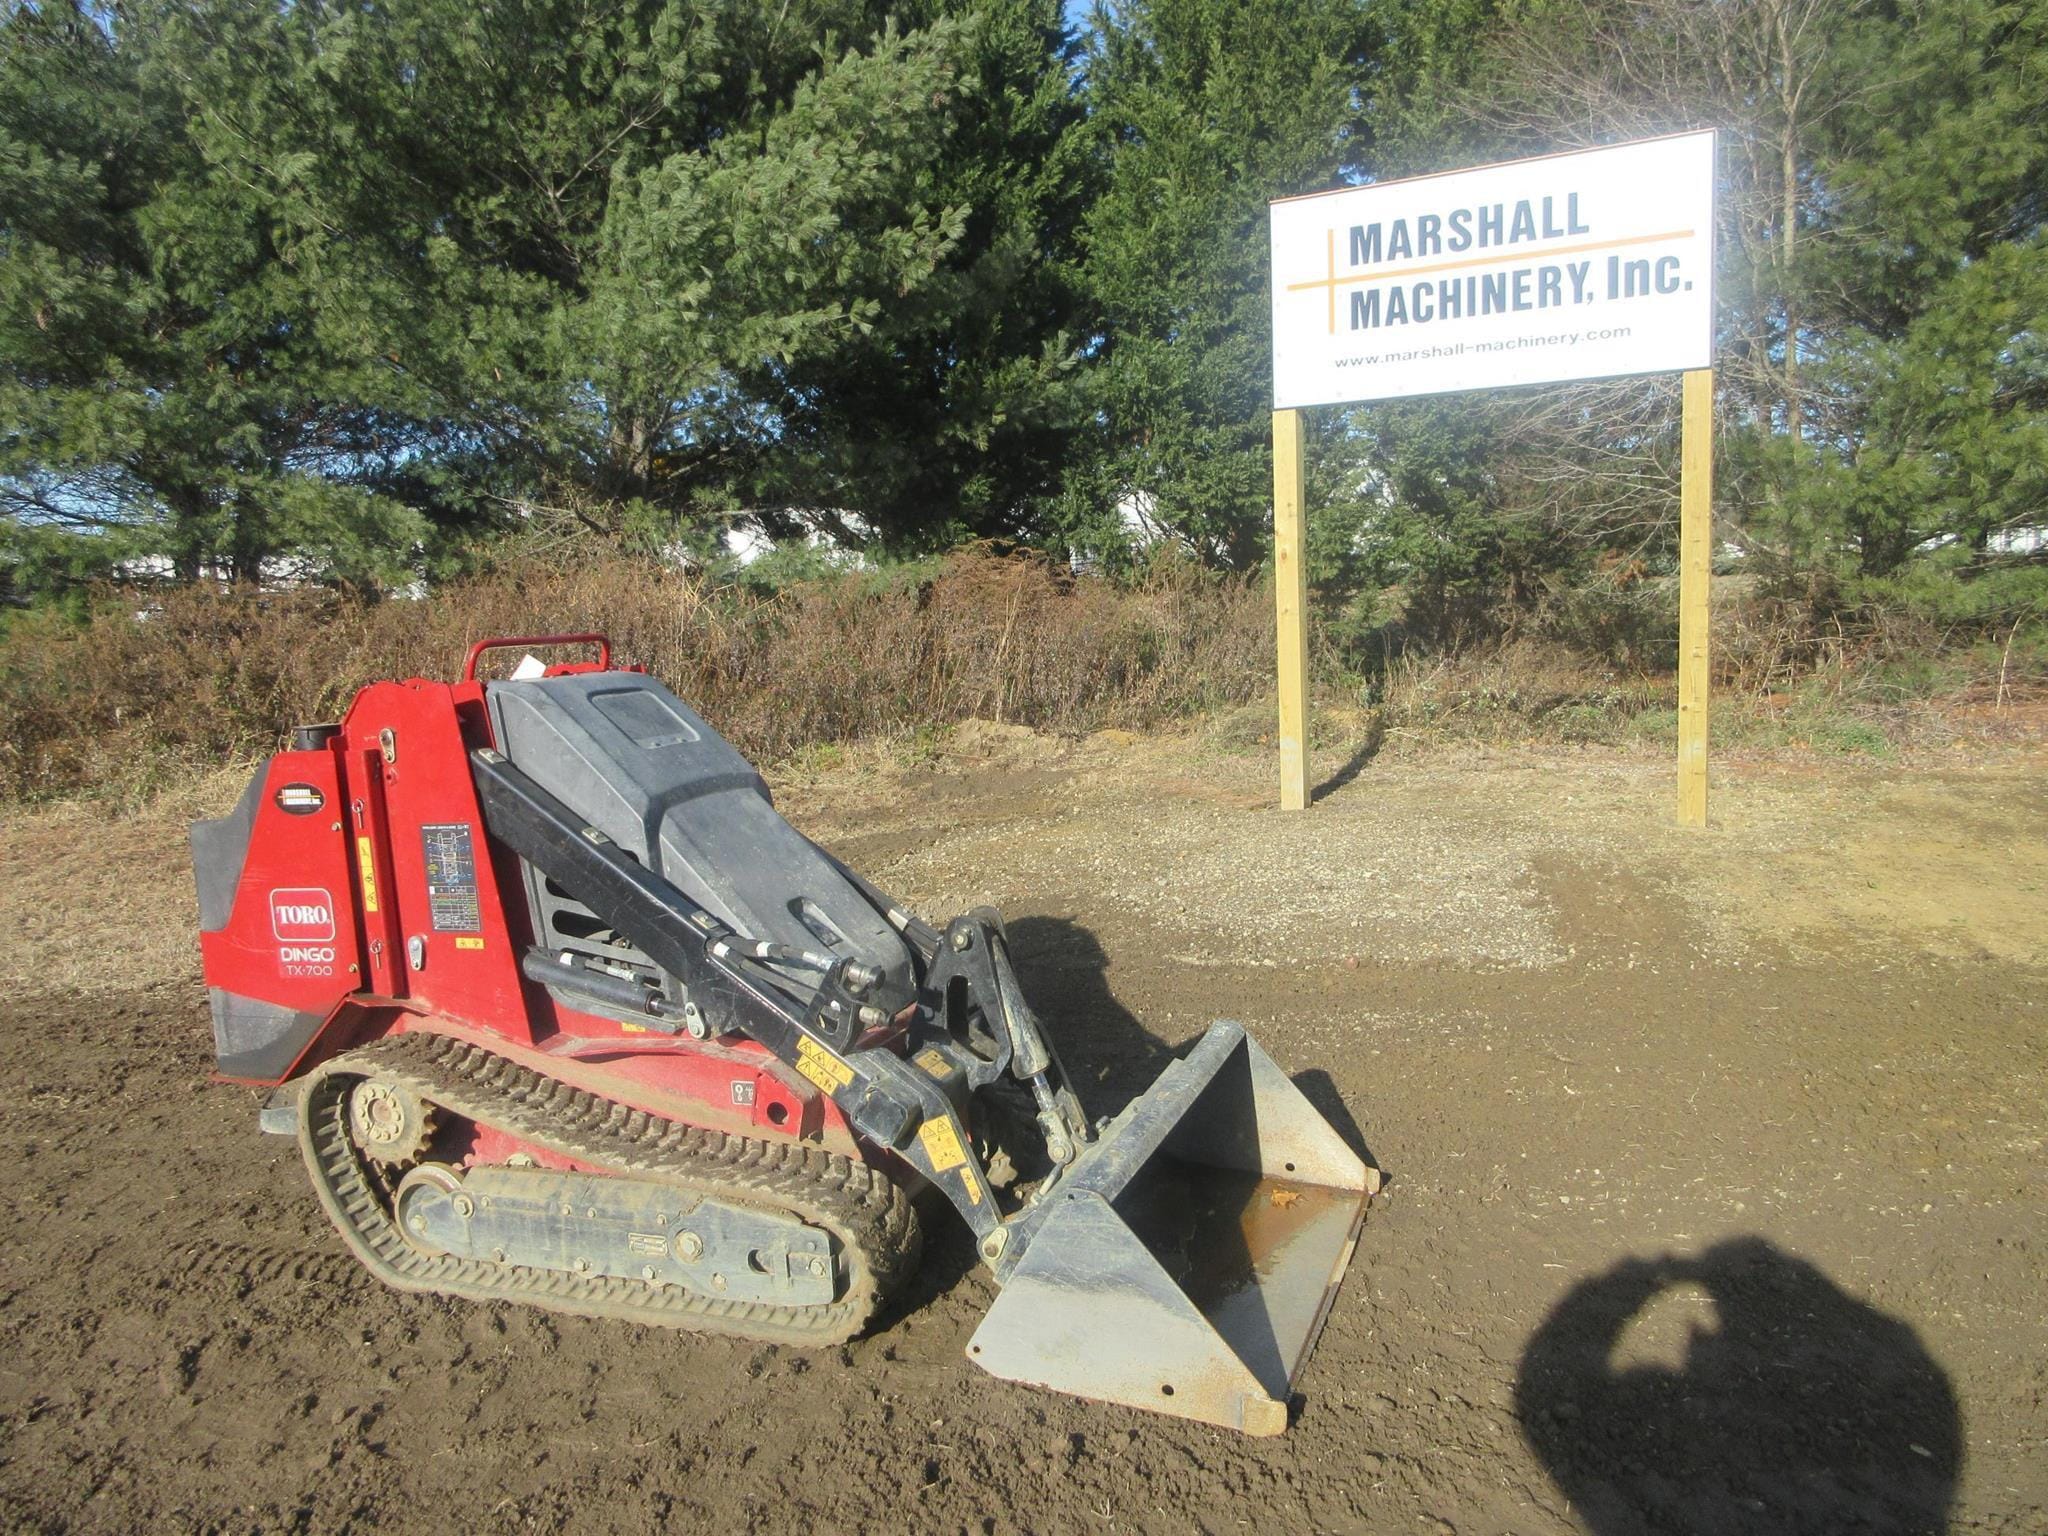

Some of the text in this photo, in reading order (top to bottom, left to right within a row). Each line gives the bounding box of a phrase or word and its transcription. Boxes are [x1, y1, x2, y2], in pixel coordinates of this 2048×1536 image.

[1350, 192, 1590, 266] MARSHALL
[1350, 255, 1694, 331] MACHINERY, Inc.
[1335, 325, 1632, 368] www.marshall-machinery.com
[276, 905, 329, 924] TORO
[281, 947, 335, 962] DINGO
